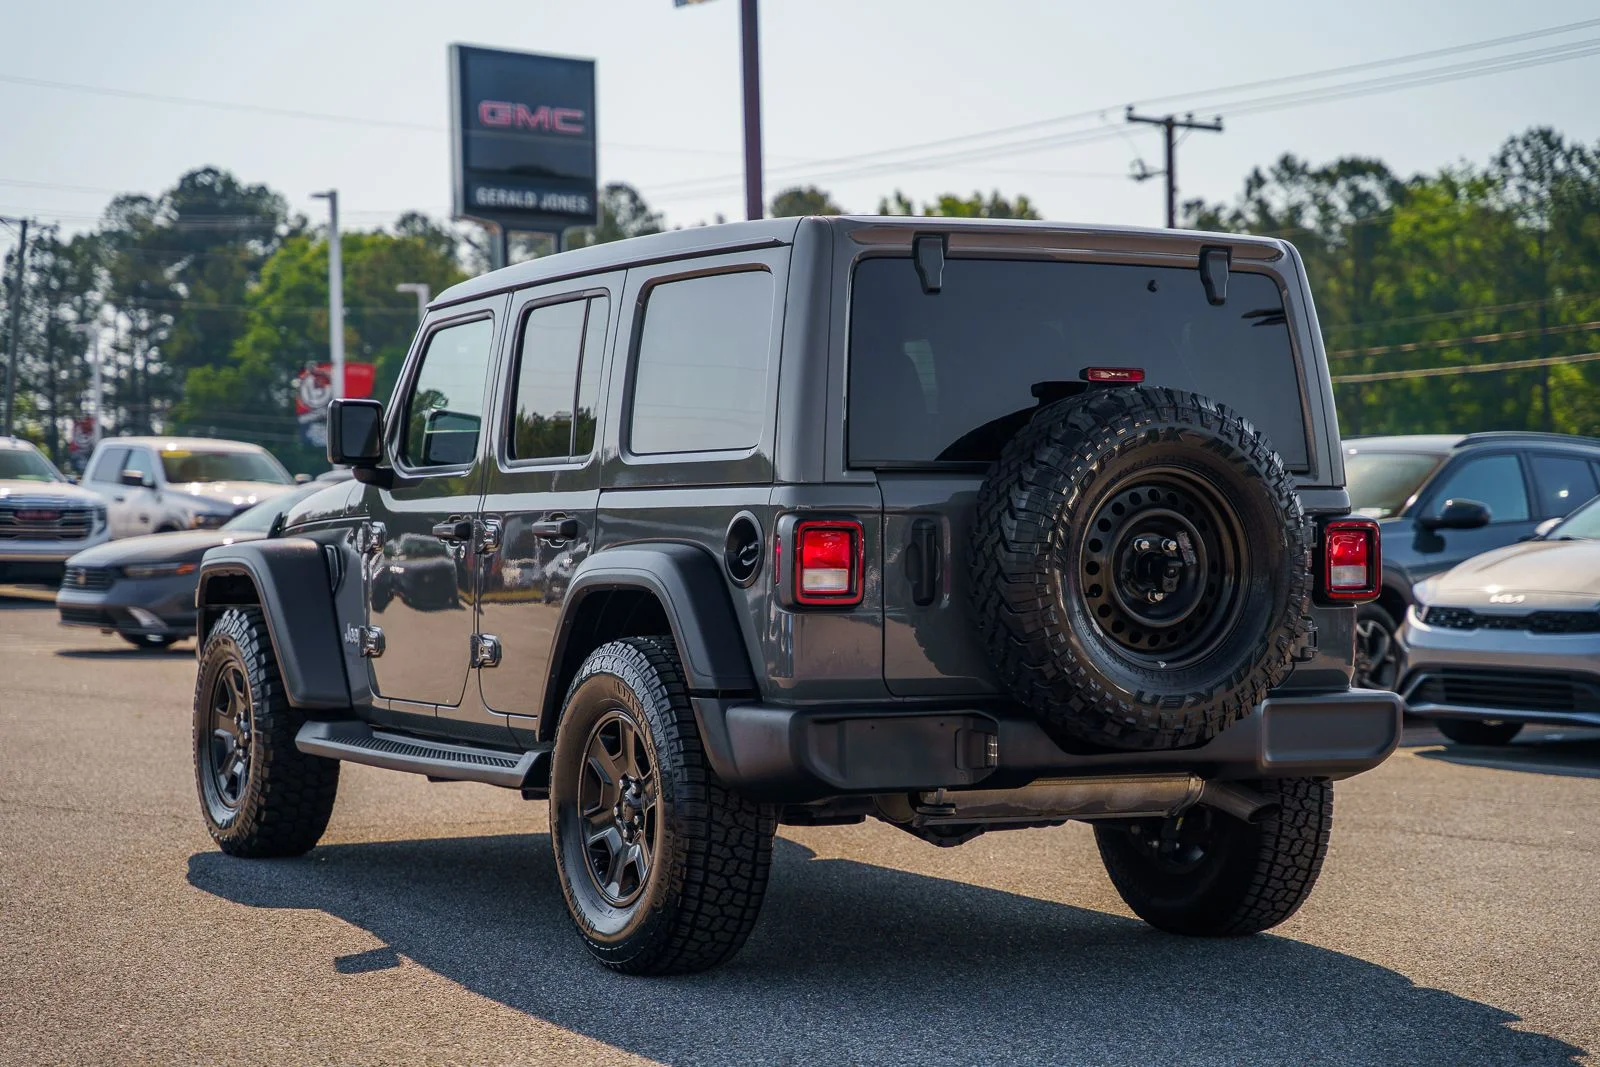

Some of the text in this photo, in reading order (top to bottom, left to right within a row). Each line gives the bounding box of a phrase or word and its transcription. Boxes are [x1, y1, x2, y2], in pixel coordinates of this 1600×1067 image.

[479, 101, 584, 134] GMC
[476, 187, 588, 214] GERALD JONES
